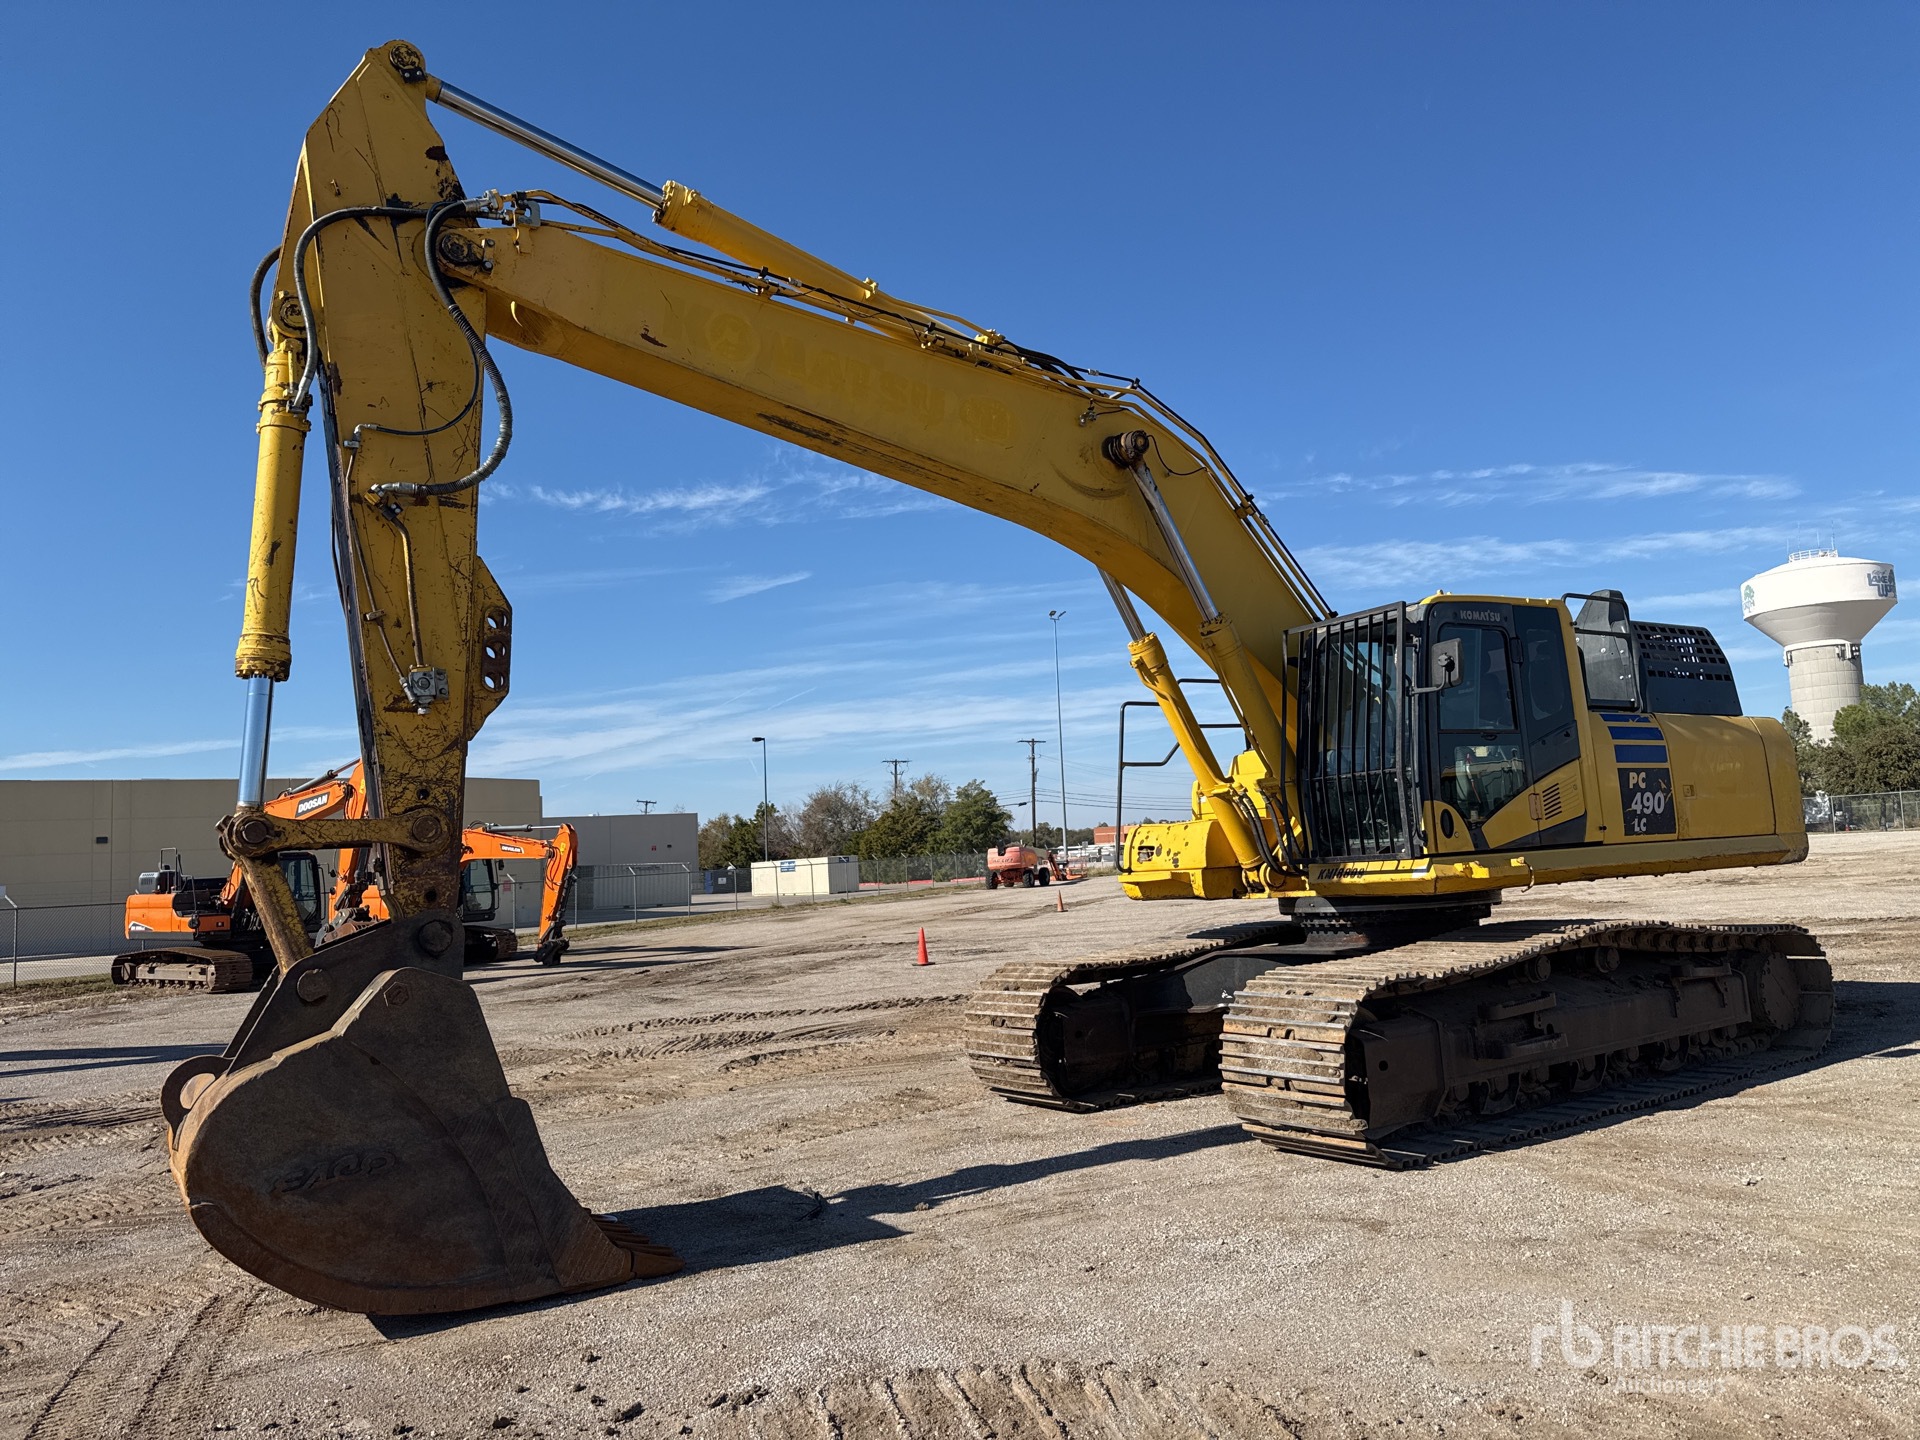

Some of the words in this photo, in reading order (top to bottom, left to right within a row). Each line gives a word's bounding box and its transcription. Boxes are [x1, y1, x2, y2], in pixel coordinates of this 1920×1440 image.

[1460, 610, 1501, 622] KOMATSU
[1629, 771, 1646, 789] PC
[297, 793, 328, 813] DOOSAN
[1631, 791, 1665, 815] 490
[1634, 817, 1647, 832] LC
